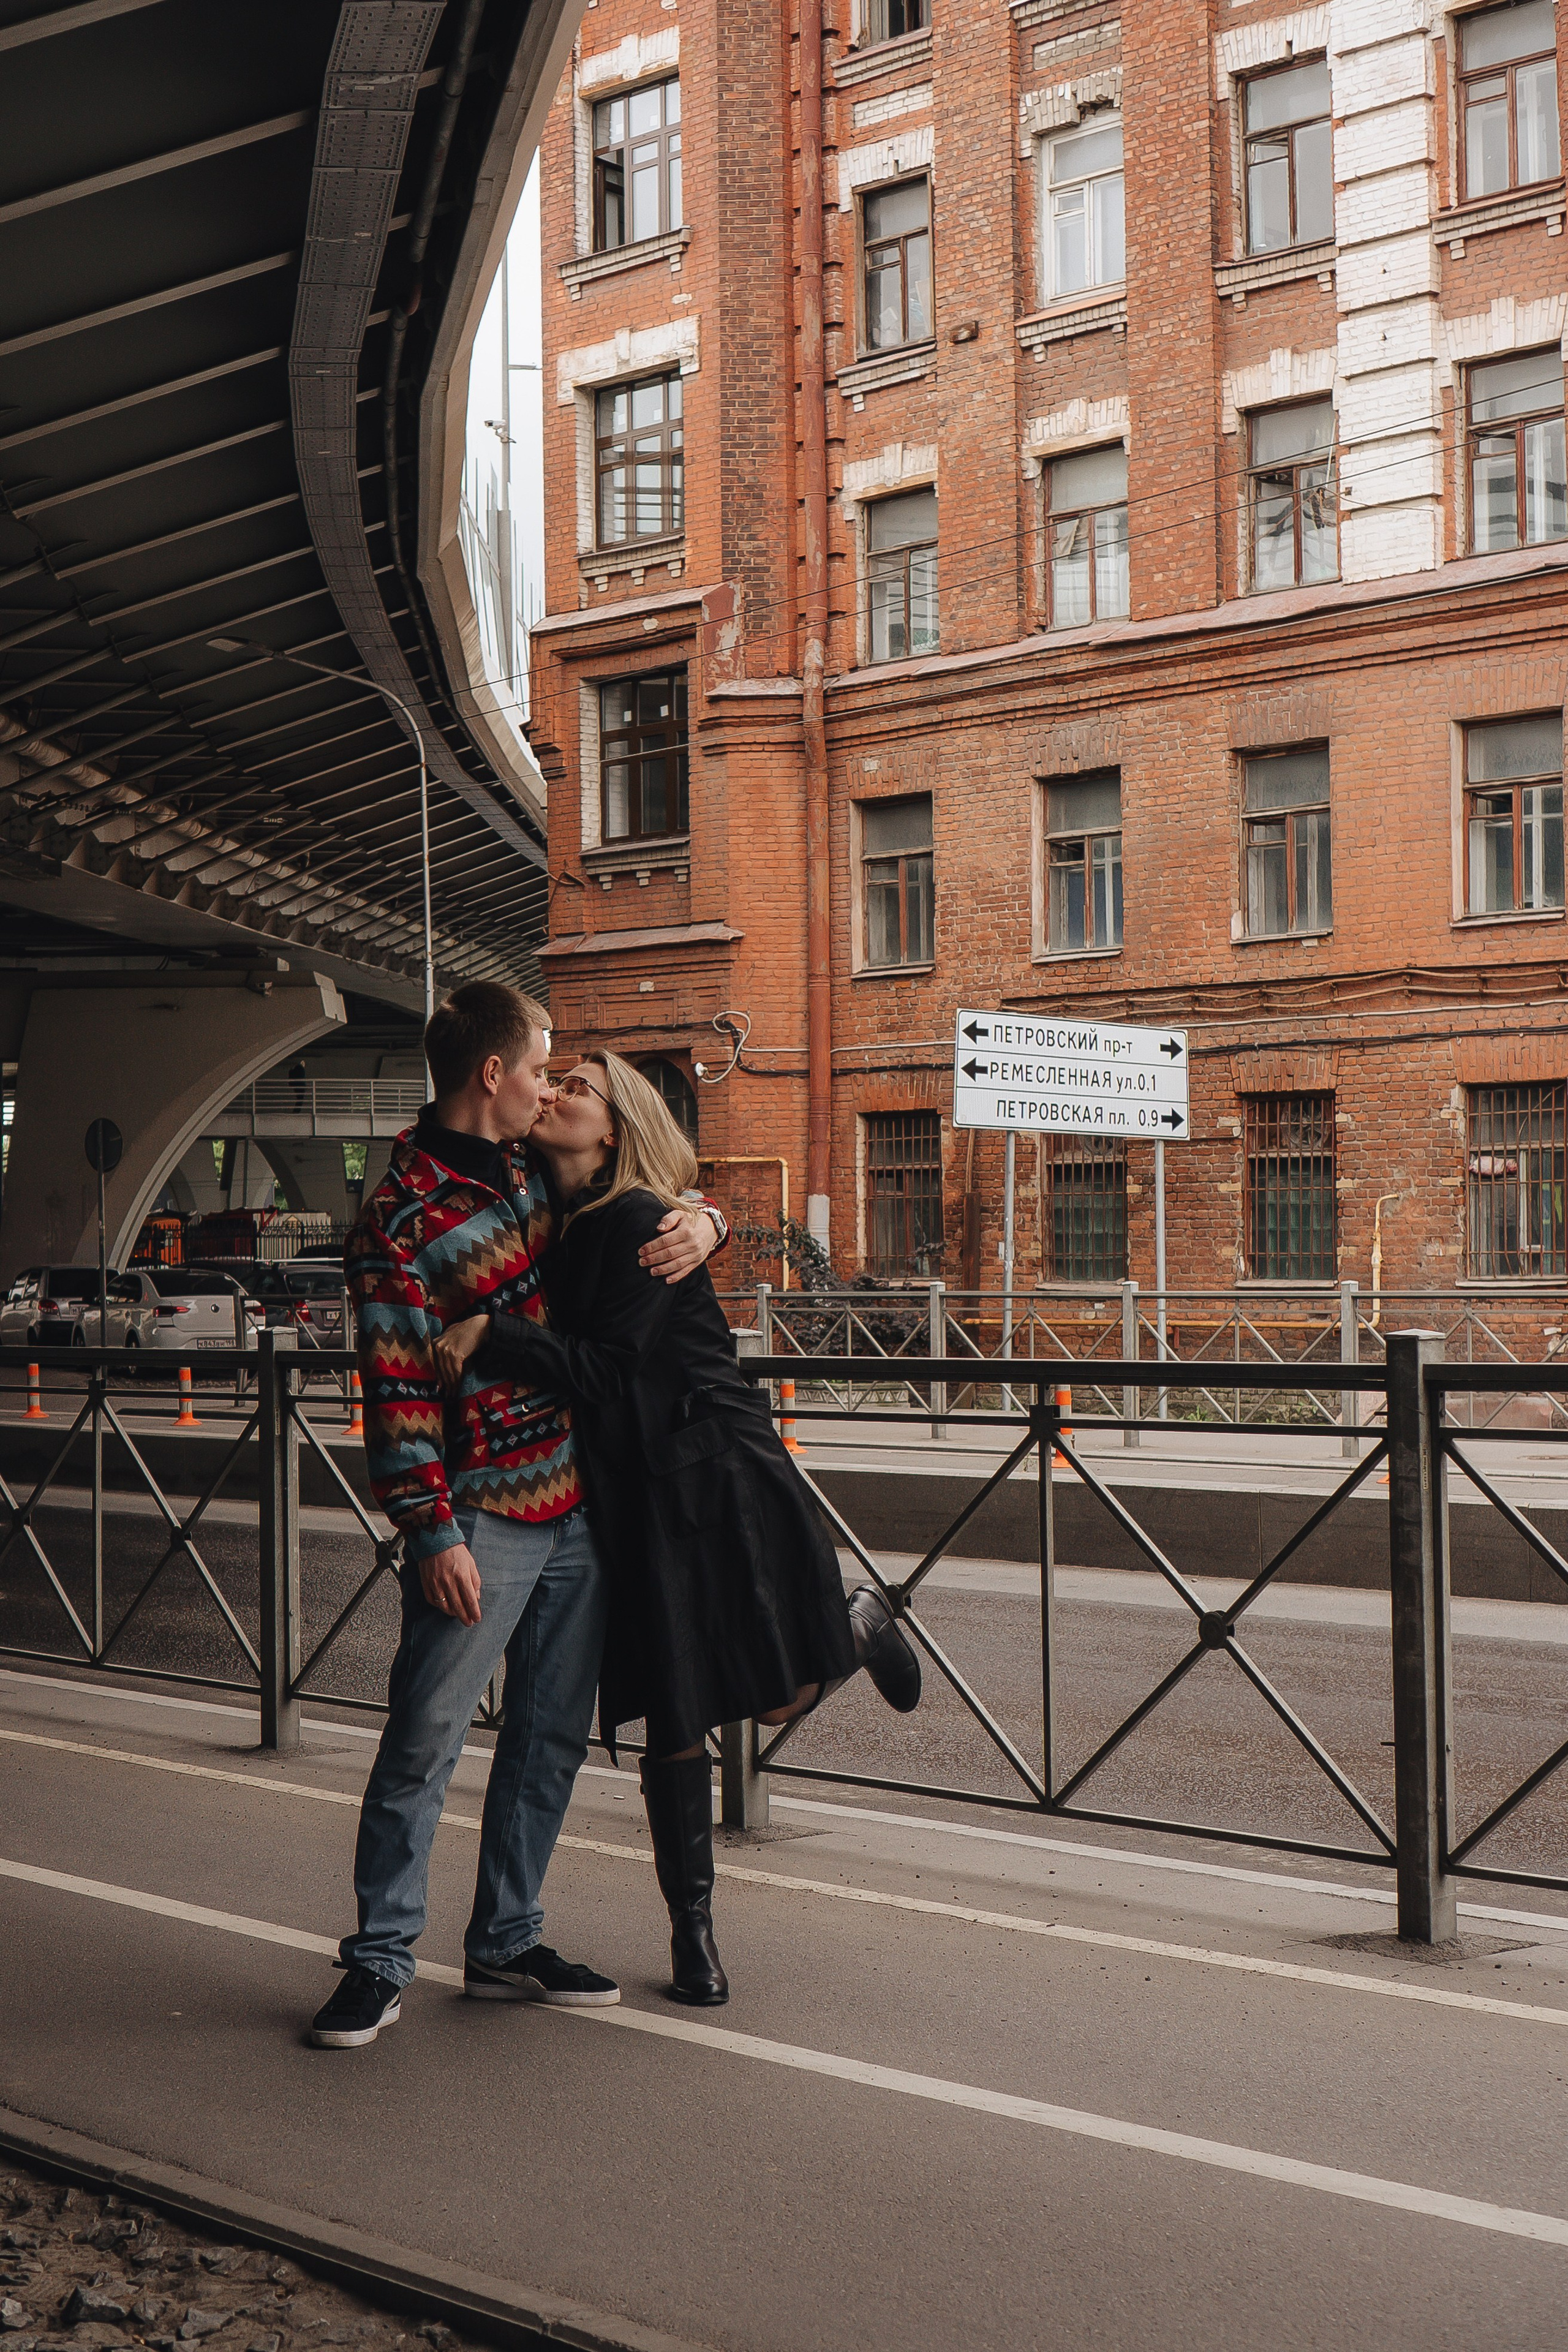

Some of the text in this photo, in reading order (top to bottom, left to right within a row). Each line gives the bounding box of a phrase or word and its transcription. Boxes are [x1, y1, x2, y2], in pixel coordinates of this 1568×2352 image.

[994, 1024, 1133, 1057] ПЕТРОВСКИЙ пр-т
[990, 1061, 1111, 1088] РЕМЕСЛЕННАЯ
[997, 1099, 1159, 1128] ПЕТРОВСКАЯ пл. 0,9
